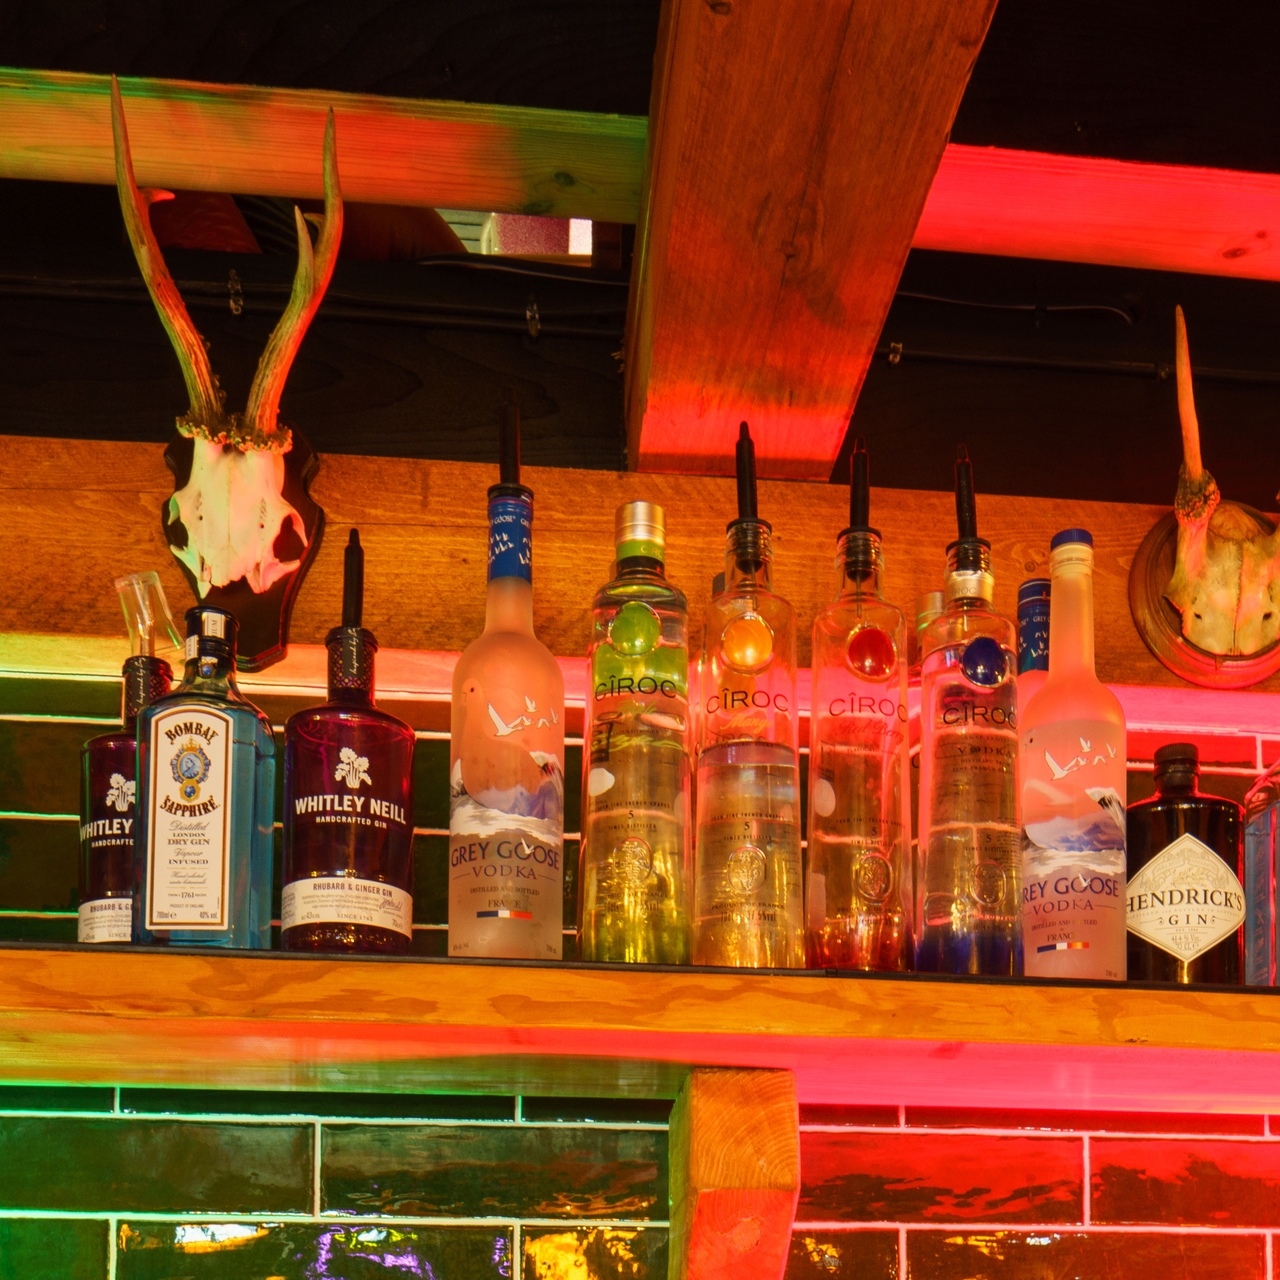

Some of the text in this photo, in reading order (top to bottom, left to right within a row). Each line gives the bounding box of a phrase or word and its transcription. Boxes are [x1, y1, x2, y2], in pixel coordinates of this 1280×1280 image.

[595, 676, 677, 702] CÎROC
[706, 689, 790, 715] CÎROC
[829, 691, 909, 724] CÎROC
[942, 701, 1016, 730] CÎROC
[164, 721, 220, 746] BOMBAY
[159, 794, 219, 818] SAPPHIRE
[294, 794, 407, 825] WHITLEY NEILL
[627, 810, 634, 820] 5
[81, 818, 134, 843] WHITLEY
[169, 819, 210, 832] Distilled
[315, 815, 388, 830] HANDCRAFTED GIN
[167, 838, 211, 846] DRY GIN
[168, 858, 209, 866] INFUSED
[173, 847, 203, 859] Vapour
[450, 837, 560, 872] GREY GOOSE
[471, 864, 538, 882] VODKA
[313, 882, 393, 898] RHUBARB & GINGER GIN
[1053, 875, 1119, 899] GOOSE
[1032, 898, 1095, 917] VODKA
[1168, 914, 1209, 926] GIN
